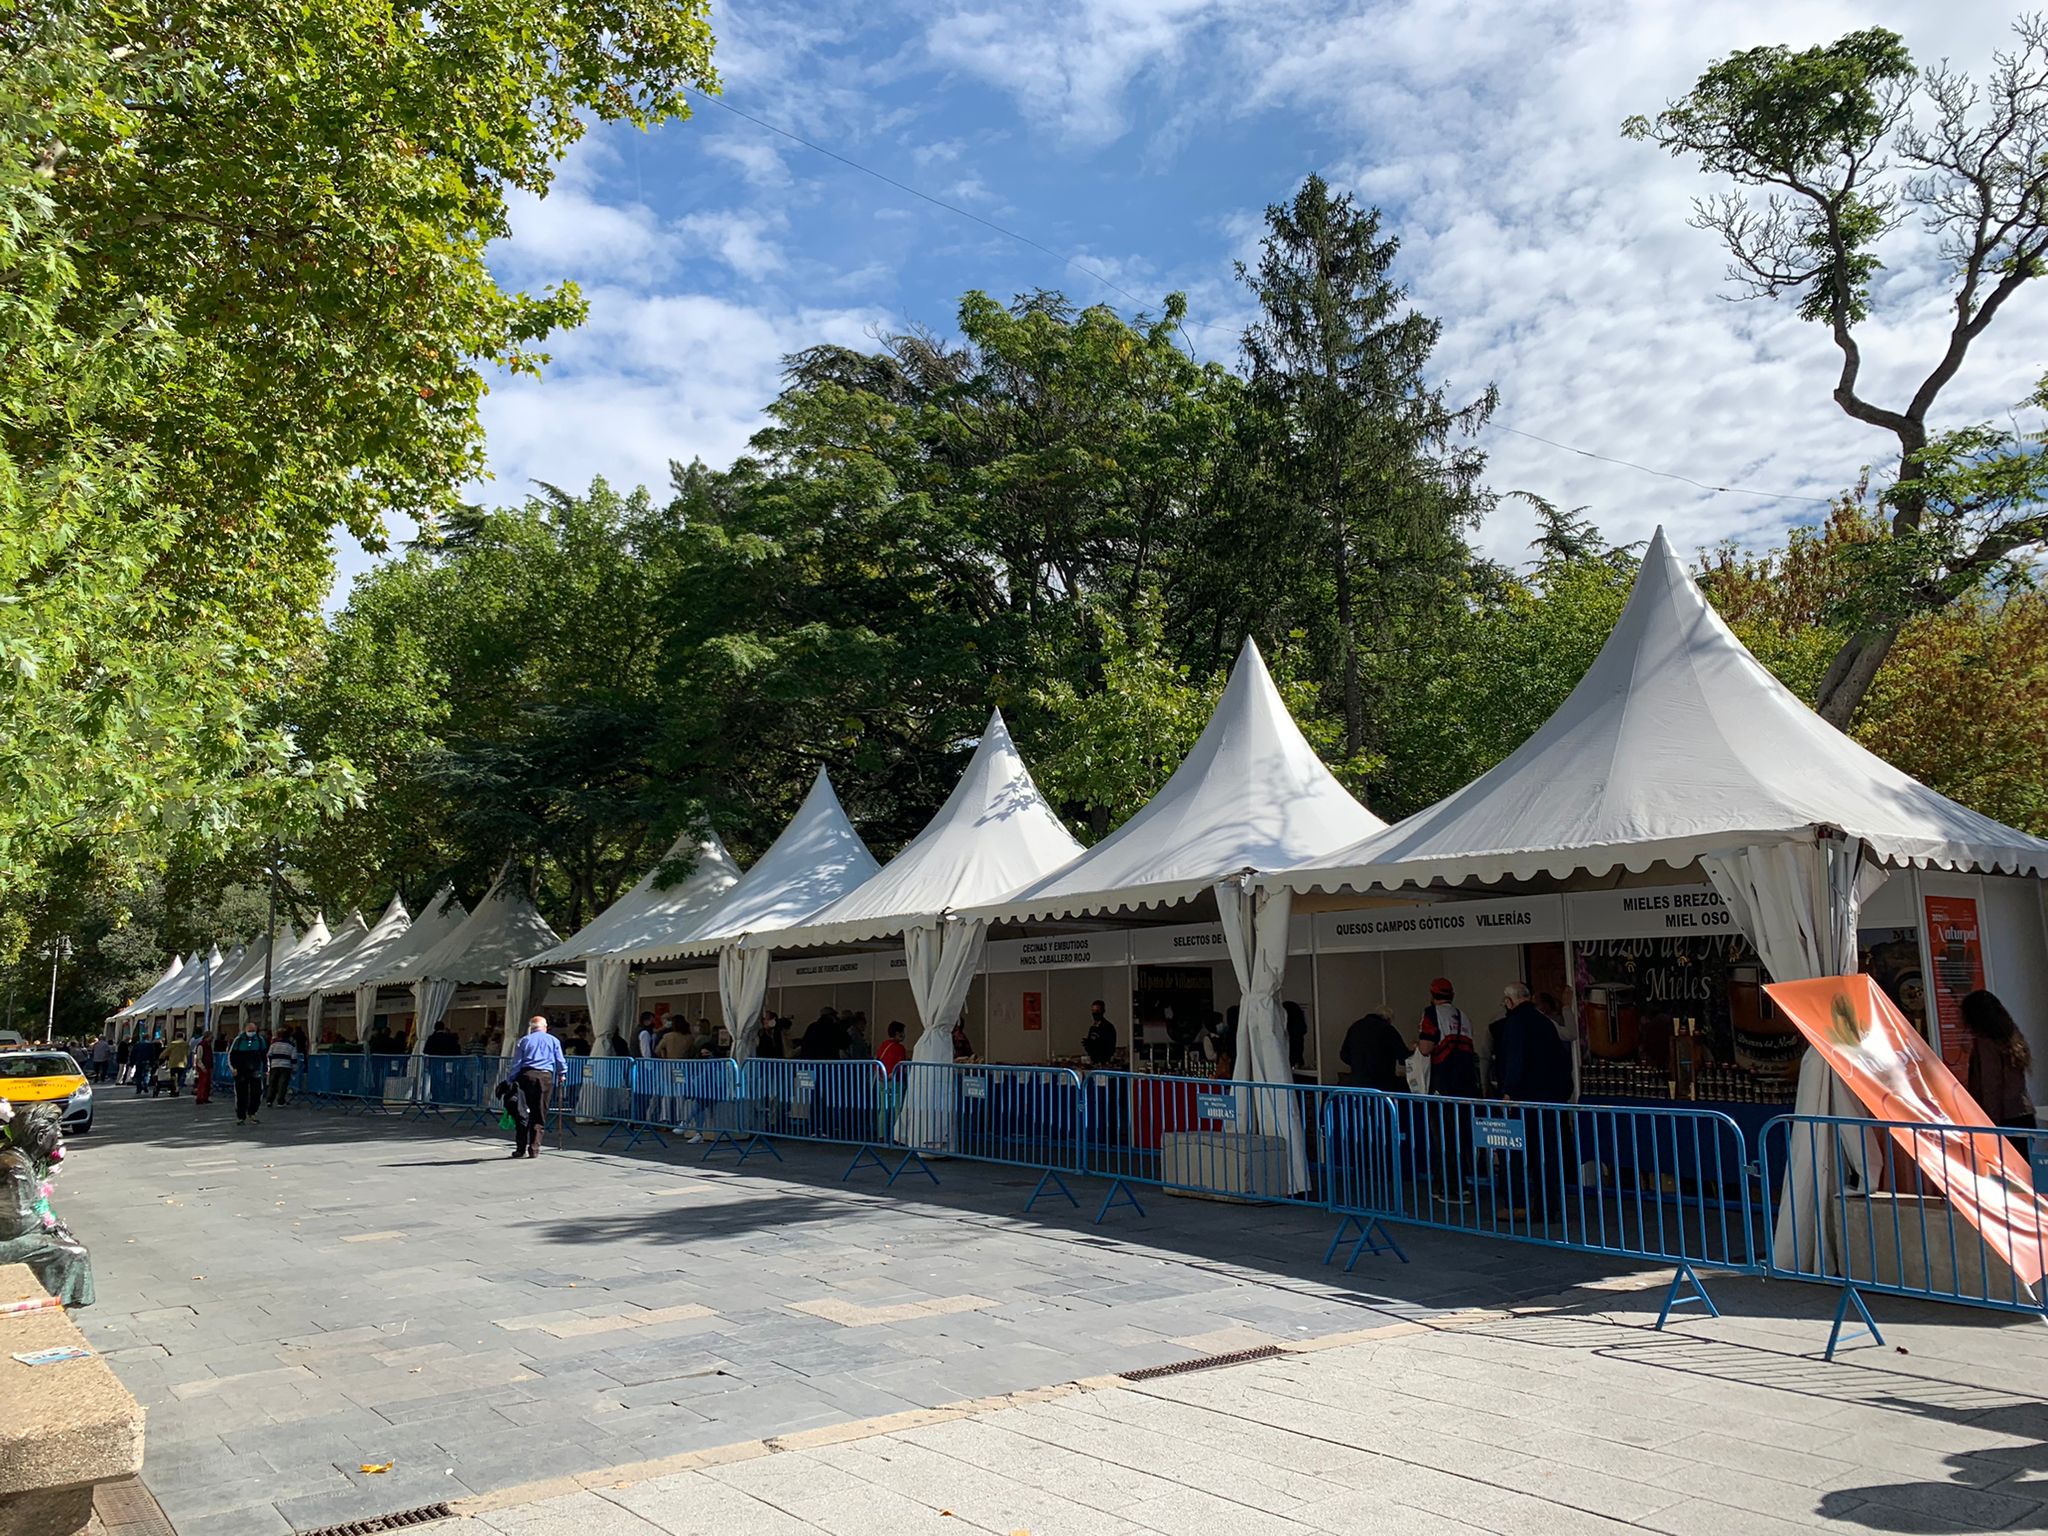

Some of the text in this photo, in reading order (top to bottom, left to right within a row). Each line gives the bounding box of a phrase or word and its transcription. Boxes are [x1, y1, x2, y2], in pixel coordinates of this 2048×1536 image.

[1623, 896, 1669, 911] MIELES
[1336, 910, 1531, 935] QUESOS CAMPOS GÓTICOS VILLERÍAS
[1665, 911, 1730, 927] MIEL OSO
[1930, 923, 1978, 943] Naturpal
[1022, 939, 1089, 953] CECINAS Y EMBUTIDOS
[1173, 935, 1210, 947] SELECTOS
[1211, 934, 1222, 945] DE
[1038, 953, 1073, 964] CABALLERO
[1074, 952, 1091, 963] ROJO
[1645, 967, 1712, 1002] Mieles
[1207, 1107, 1235, 1119] OBRAS
[1487, 1134, 1523, 1148] OBRAS
